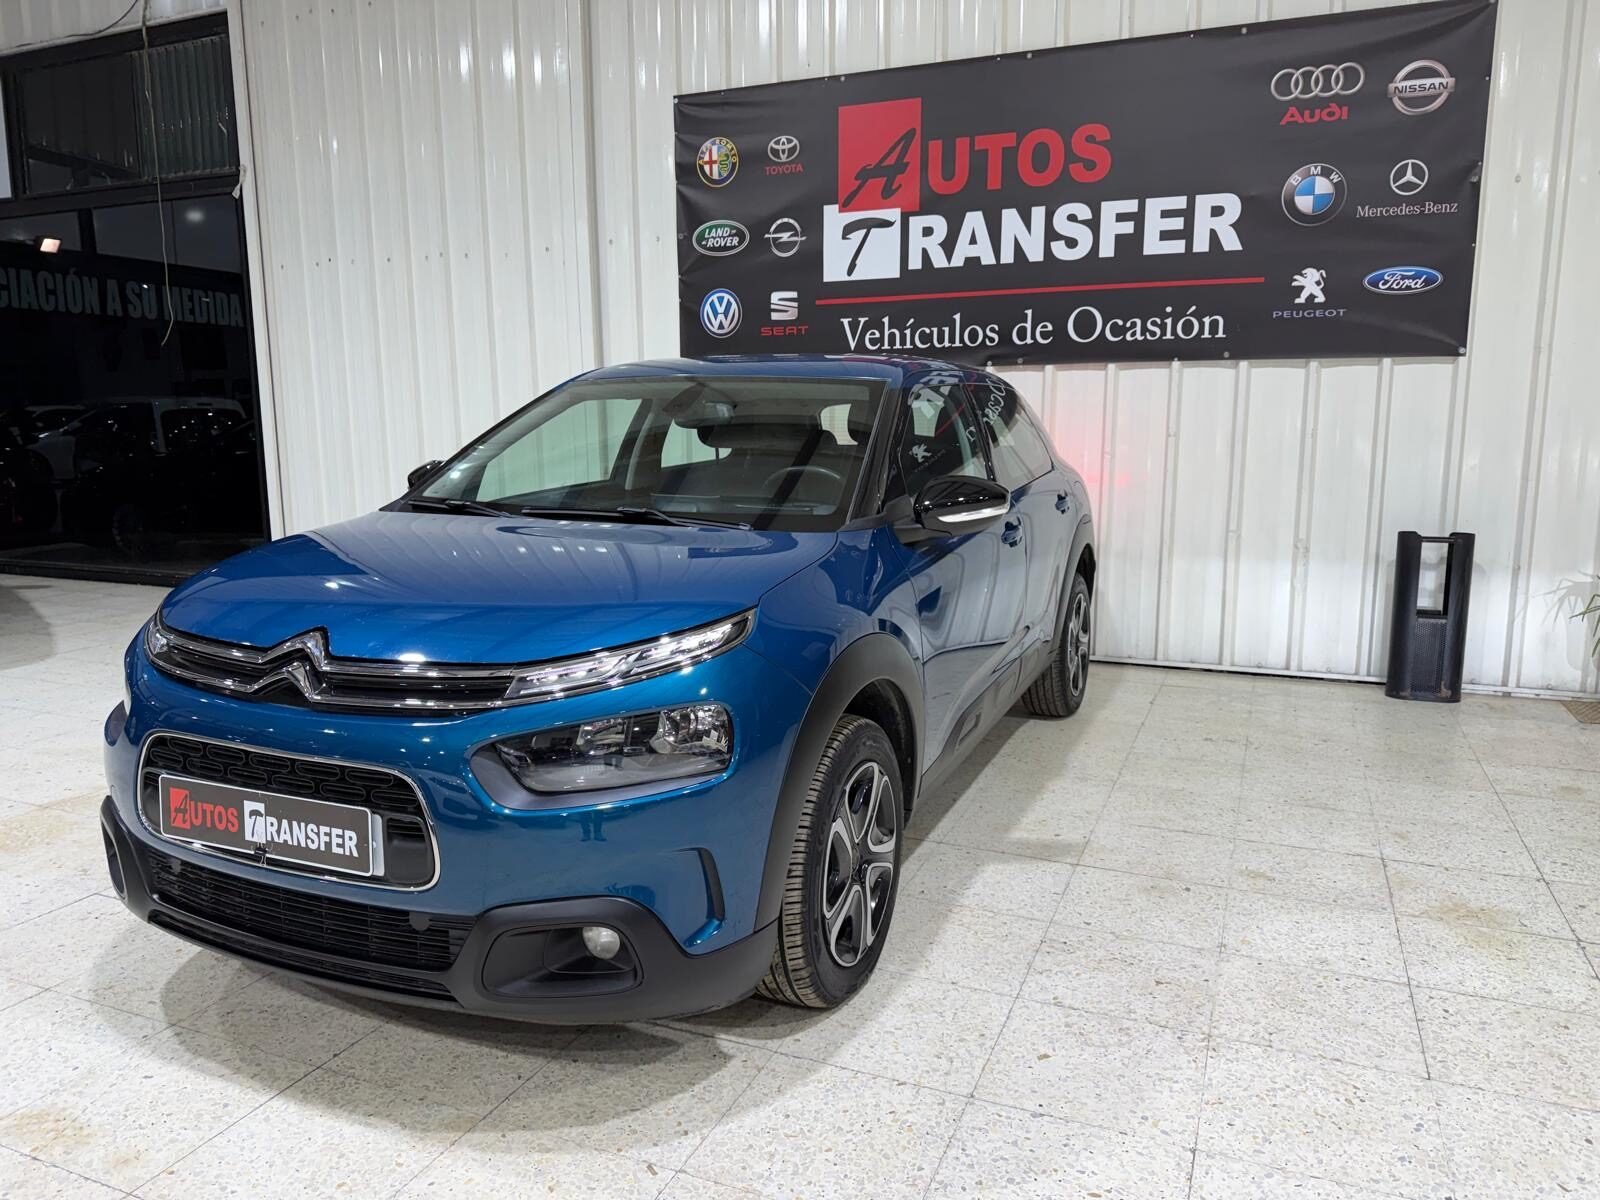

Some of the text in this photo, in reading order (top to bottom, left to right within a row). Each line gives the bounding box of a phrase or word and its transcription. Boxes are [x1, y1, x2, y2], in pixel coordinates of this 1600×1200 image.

[1391, 78, 1450, 96] NISSAN
[1279, 102, 1349, 126] Audi
[764, 163, 804, 176] TOYOTA
[843, 122, 1112, 208] AUTOS
[1289, 165, 1342, 186] BMW
[1356, 200, 1459, 219] Mercedes-Benz
[704, 227, 730, 238] LAND
[706, 237, 740, 248] ROVER
[841, 192, 1243, 277] TRANSFER
[1377, 271, 1426, 291] Ford
[106, 278, 123, 317] A
[126, 281, 158, 320] SU
[162, 285, 245, 328] MEDIDA
[1272, 308, 1348, 319] PEUGEOT
[760, 325, 809, 336] SEAT
[840, 305, 1227, 351] Vehículos de Ocasión
[171, 793, 359, 857] AUTOS TRANSFER
